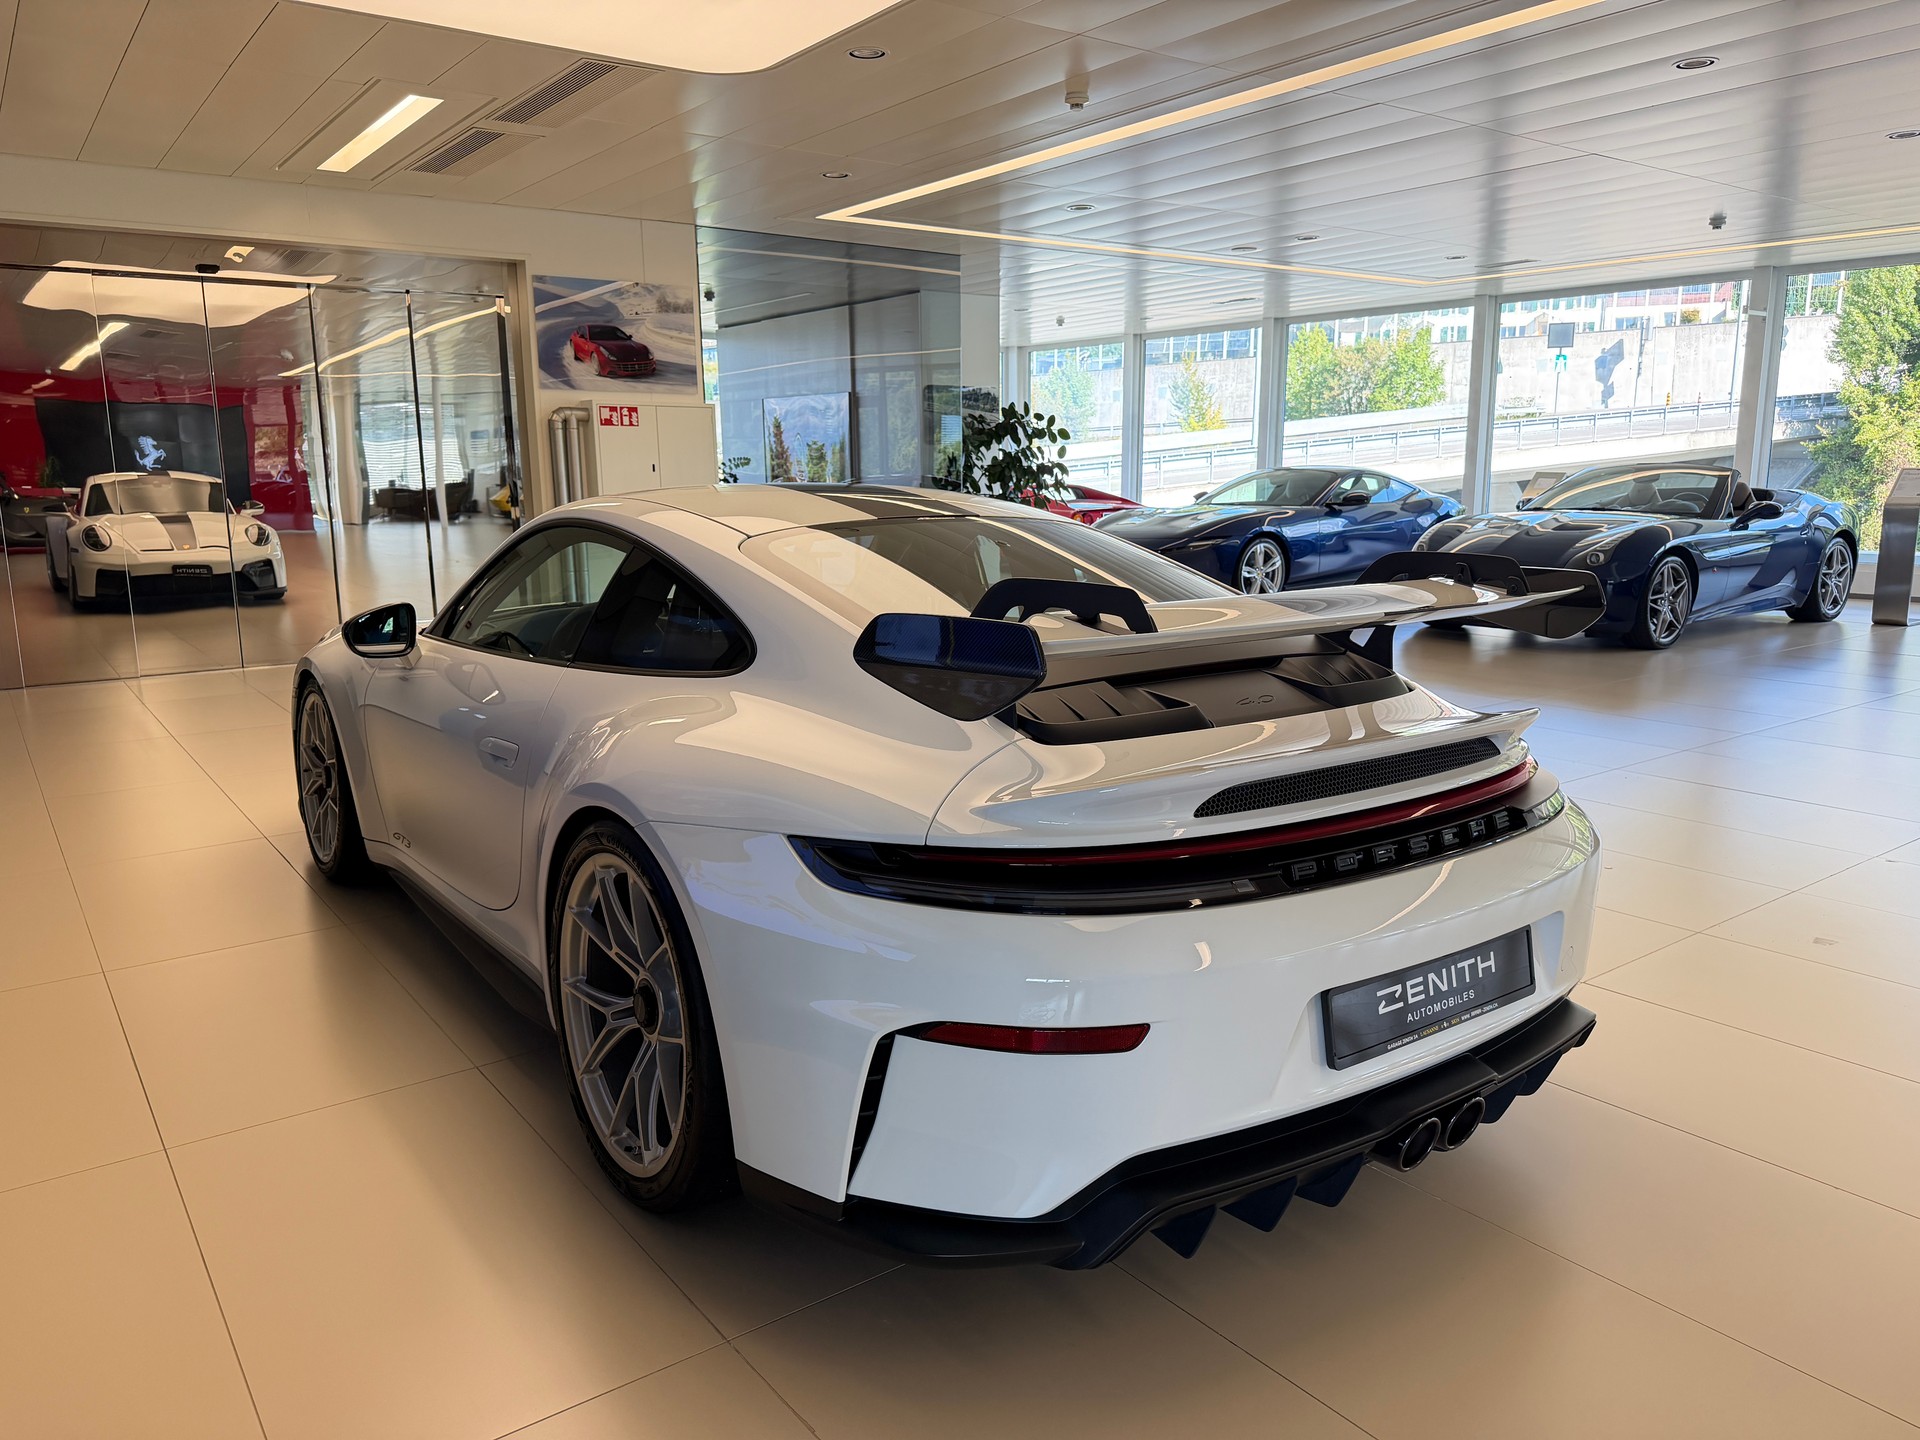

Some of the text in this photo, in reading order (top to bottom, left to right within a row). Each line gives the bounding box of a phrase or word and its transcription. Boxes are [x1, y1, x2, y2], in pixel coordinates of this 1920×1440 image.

[392, 832, 412, 849] GT3
[1291, 810, 1510, 881] PORSCHE
[1376, 951, 1496, 1015] ZENITH
[1406, 989, 1475, 1023] AUTOMOBILES
